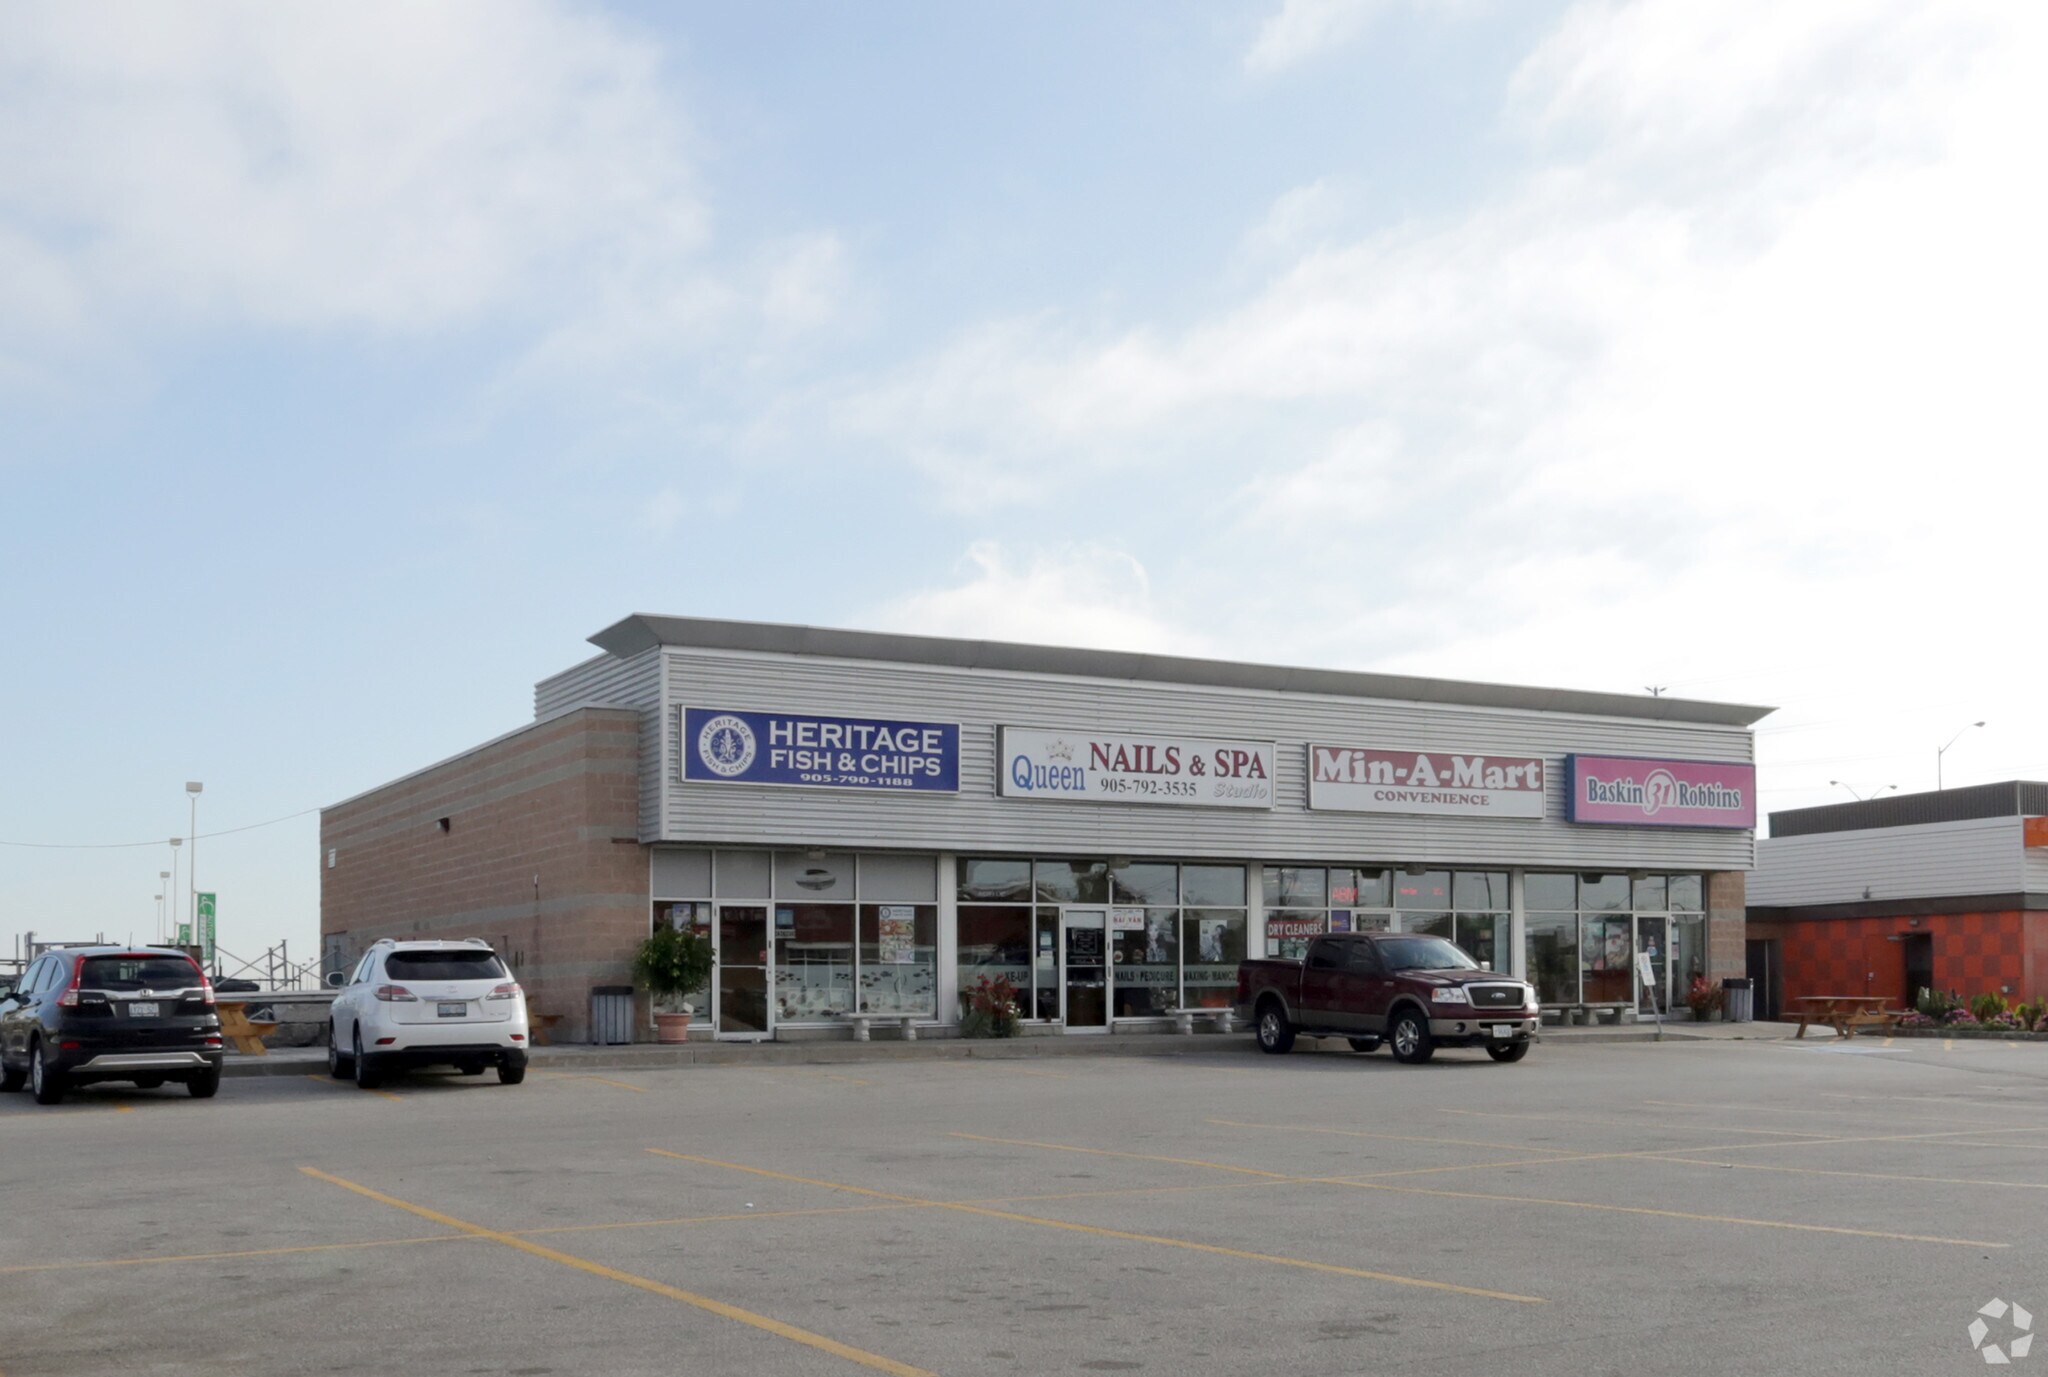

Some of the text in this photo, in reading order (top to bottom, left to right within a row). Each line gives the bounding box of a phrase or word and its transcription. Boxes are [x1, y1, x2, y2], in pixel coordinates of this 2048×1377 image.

[703, 718, 751, 740] HERITAGE
[769, 720, 943, 755] HERITAGE
[703, 749, 720, 770] FISH
[728, 751, 752, 773] CHIPS
[770, 749, 942, 776] FISH & CHIPS
[1012, 754, 1086, 791] Queen
[1088, 742, 1268, 780] NAILS & SPA
[1315, 748, 1541, 790] Min-A-Mart
[800, 773, 913, 787] 905-790-1188
[1101, 778, 1197, 797] 905-792-3535
[1213, 781, 1268, 800] Studio
[1374, 790, 1490, 806] CONVENIENCE
[1587, 777, 1740, 812] Baskin 31 Robbins
[1268, 923, 1323, 936] DRY CLEANERS
[1115, 971, 1174, 982] NAILS PEDICURE
